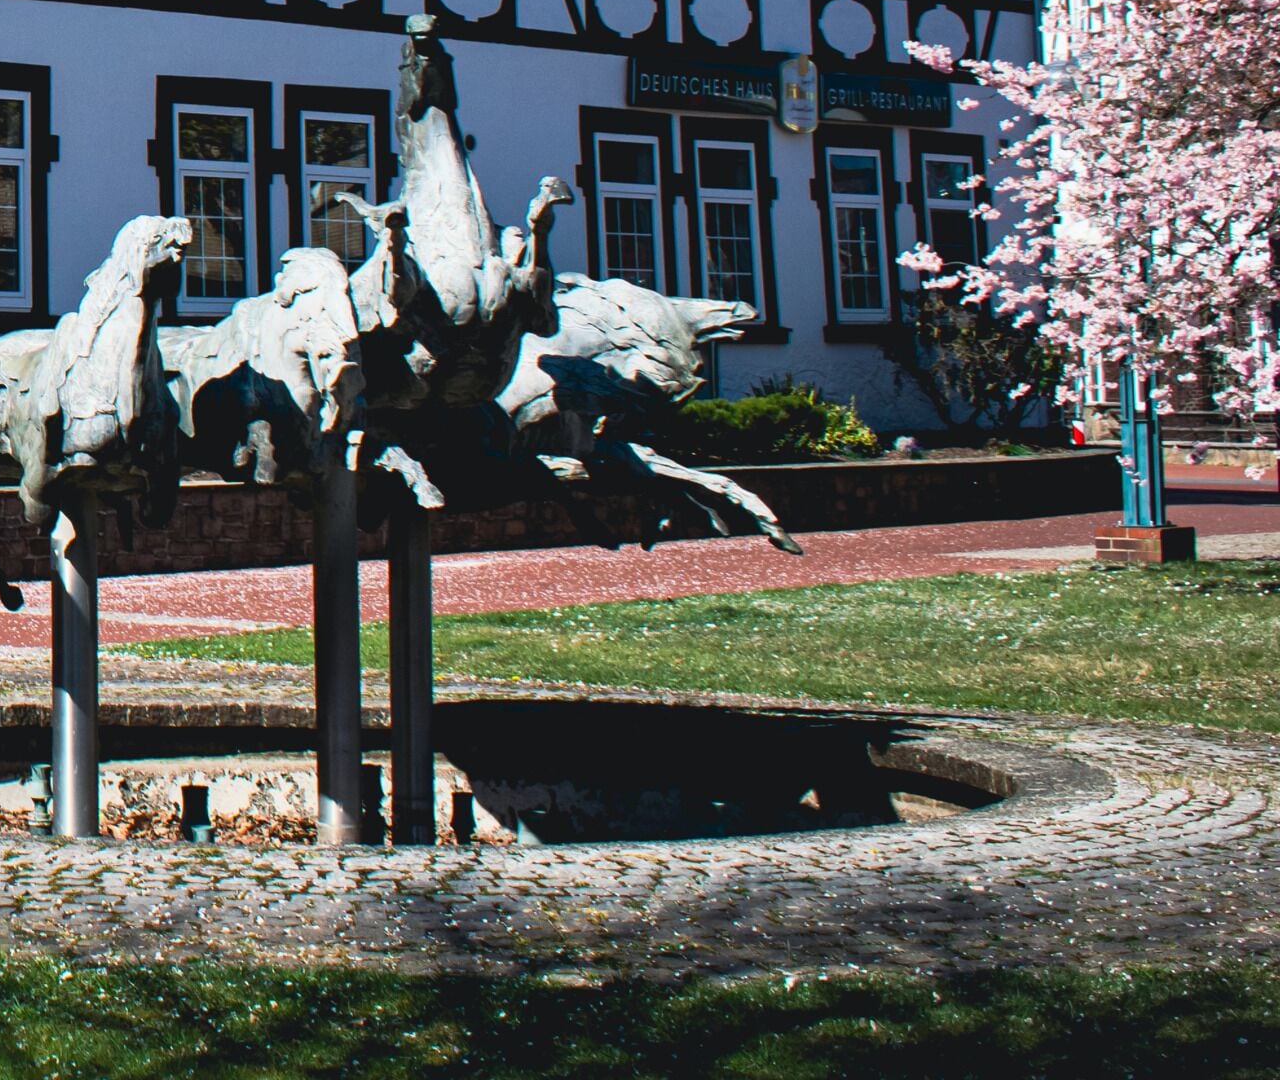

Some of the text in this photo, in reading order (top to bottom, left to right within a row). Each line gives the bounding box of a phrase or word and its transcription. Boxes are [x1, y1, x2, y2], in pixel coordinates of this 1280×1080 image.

[640, 73, 773, 100] DEUTSCHES HAUS
[827, 87, 948, 112] GRILL-RESTAURANT
